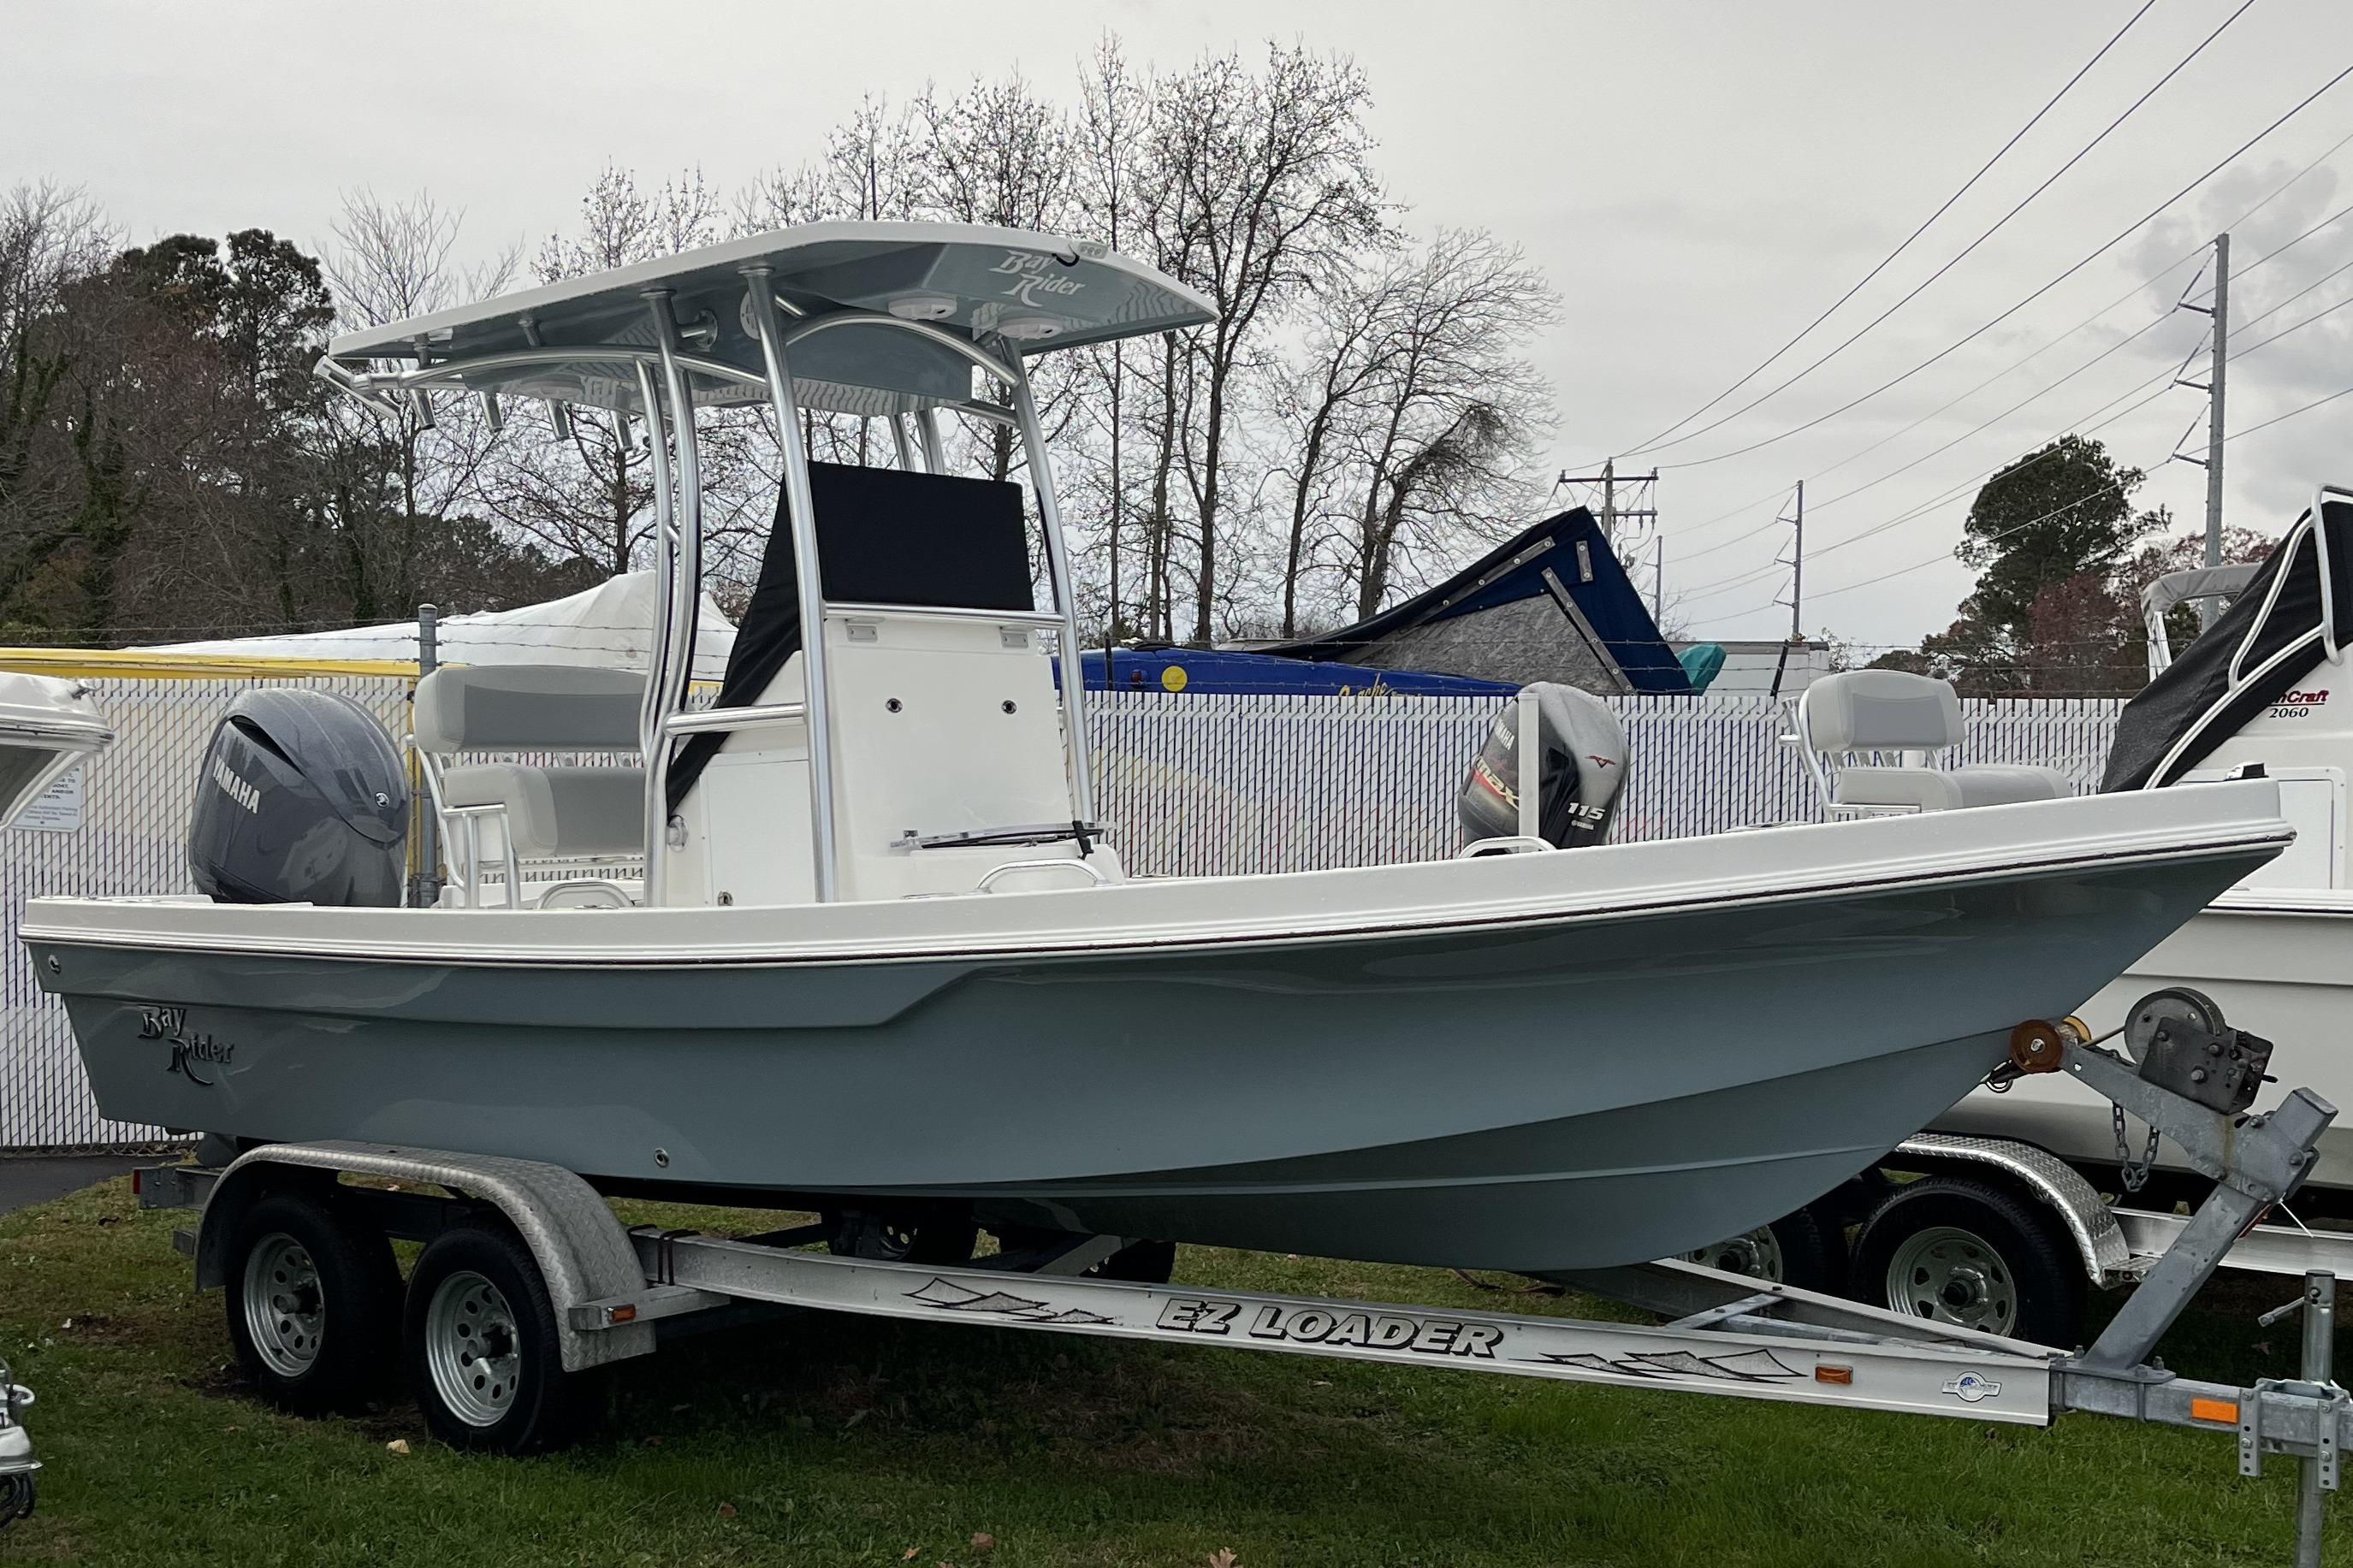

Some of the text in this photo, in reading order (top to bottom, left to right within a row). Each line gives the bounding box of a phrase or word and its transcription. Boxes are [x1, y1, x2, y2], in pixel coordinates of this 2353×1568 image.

[988, 249, 1056, 275] Bay
[1000, 272, 1086, 307] Rider
[2269, 707, 2309, 719] 2060
[2276, 689, 2329, 703] nCraft
[213, 754, 260, 814] YAMAHA
[1568, 802, 1606, 820] 115
[138, 1004, 186, 1039] Bay
[167, 1034, 234, 1086] Rider
[1156, 1298, 1504, 1358] EZ LOADER
